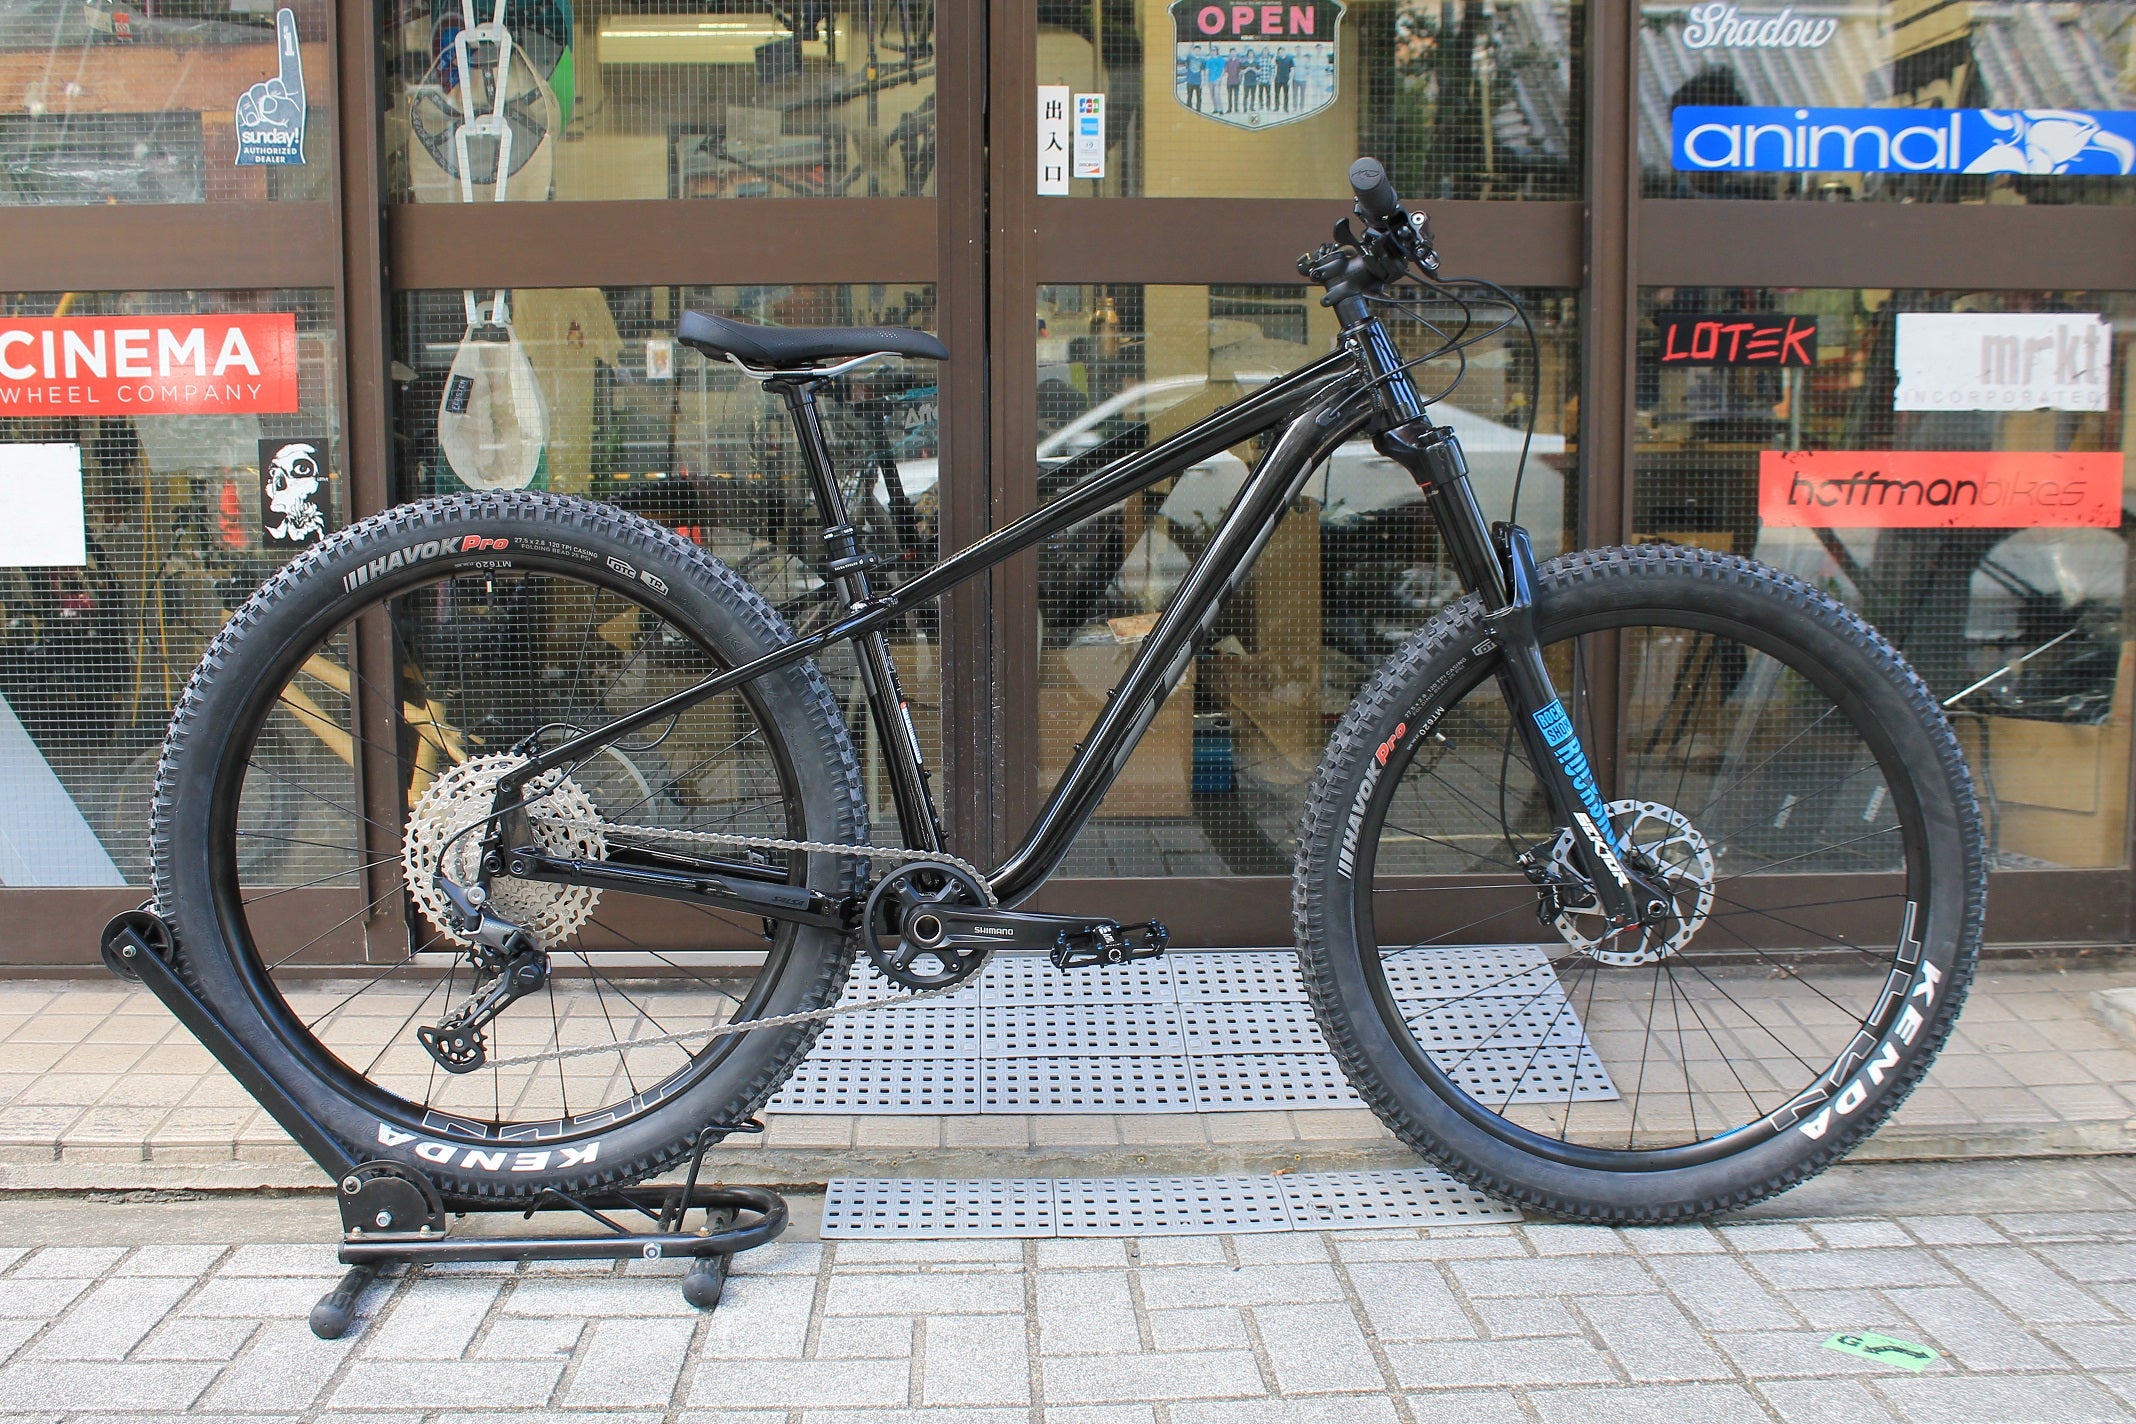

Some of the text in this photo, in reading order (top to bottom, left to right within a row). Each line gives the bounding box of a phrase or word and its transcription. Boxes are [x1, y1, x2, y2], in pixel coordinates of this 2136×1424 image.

[1197, 5, 1315, 35] OPEN
[1682, 2, 1838, 49] Shadow
[241, 127, 300, 148] sunday!
[243, 146, 298, 155] AUTHORIZED
[1044, 99, 1063, 182] 出入口
[1683, 108, 1961, 170] animal
[255, 155, 286, 164] DEALER
[0, 327, 261, 380] CINEMA
[1661, 316, 1816, 366] LOTEK
[1981, 323, 2101, 386] mrkt
[0, 383, 262, 404] WHEEL COMPANY
[1904, 389, 2103, 404] INCORPORATED
[368, 534, 510, 580] HAVOK Pro
[475, 559, 512, 568] MT620
[521, 543, 551, 552] FOLDING
[552, 547, 571, 557] BEAD
[561, 543, 573, 552] TPI
[573, 546, 599, 559] CASING
[613, 564, 636, 577] OTC
[649, 577, 663, 589] TR
[1446, 657, 1467, 675] CASING
[1419, 706, 1445, 737] MT620
[1536, 702, 1564, 730] ROCK
[1546, 716, 1573, 742] SHOX
[1342, 722, 1407, 851] HAVOK Pro
[1572, 811, 1632, 889] SEKTOR
[974, 925, 1014, 936] SHIMANO
[1798, 959, 1943, 1141] KENDA
[377, 1122, 601, 1172] KENDA
